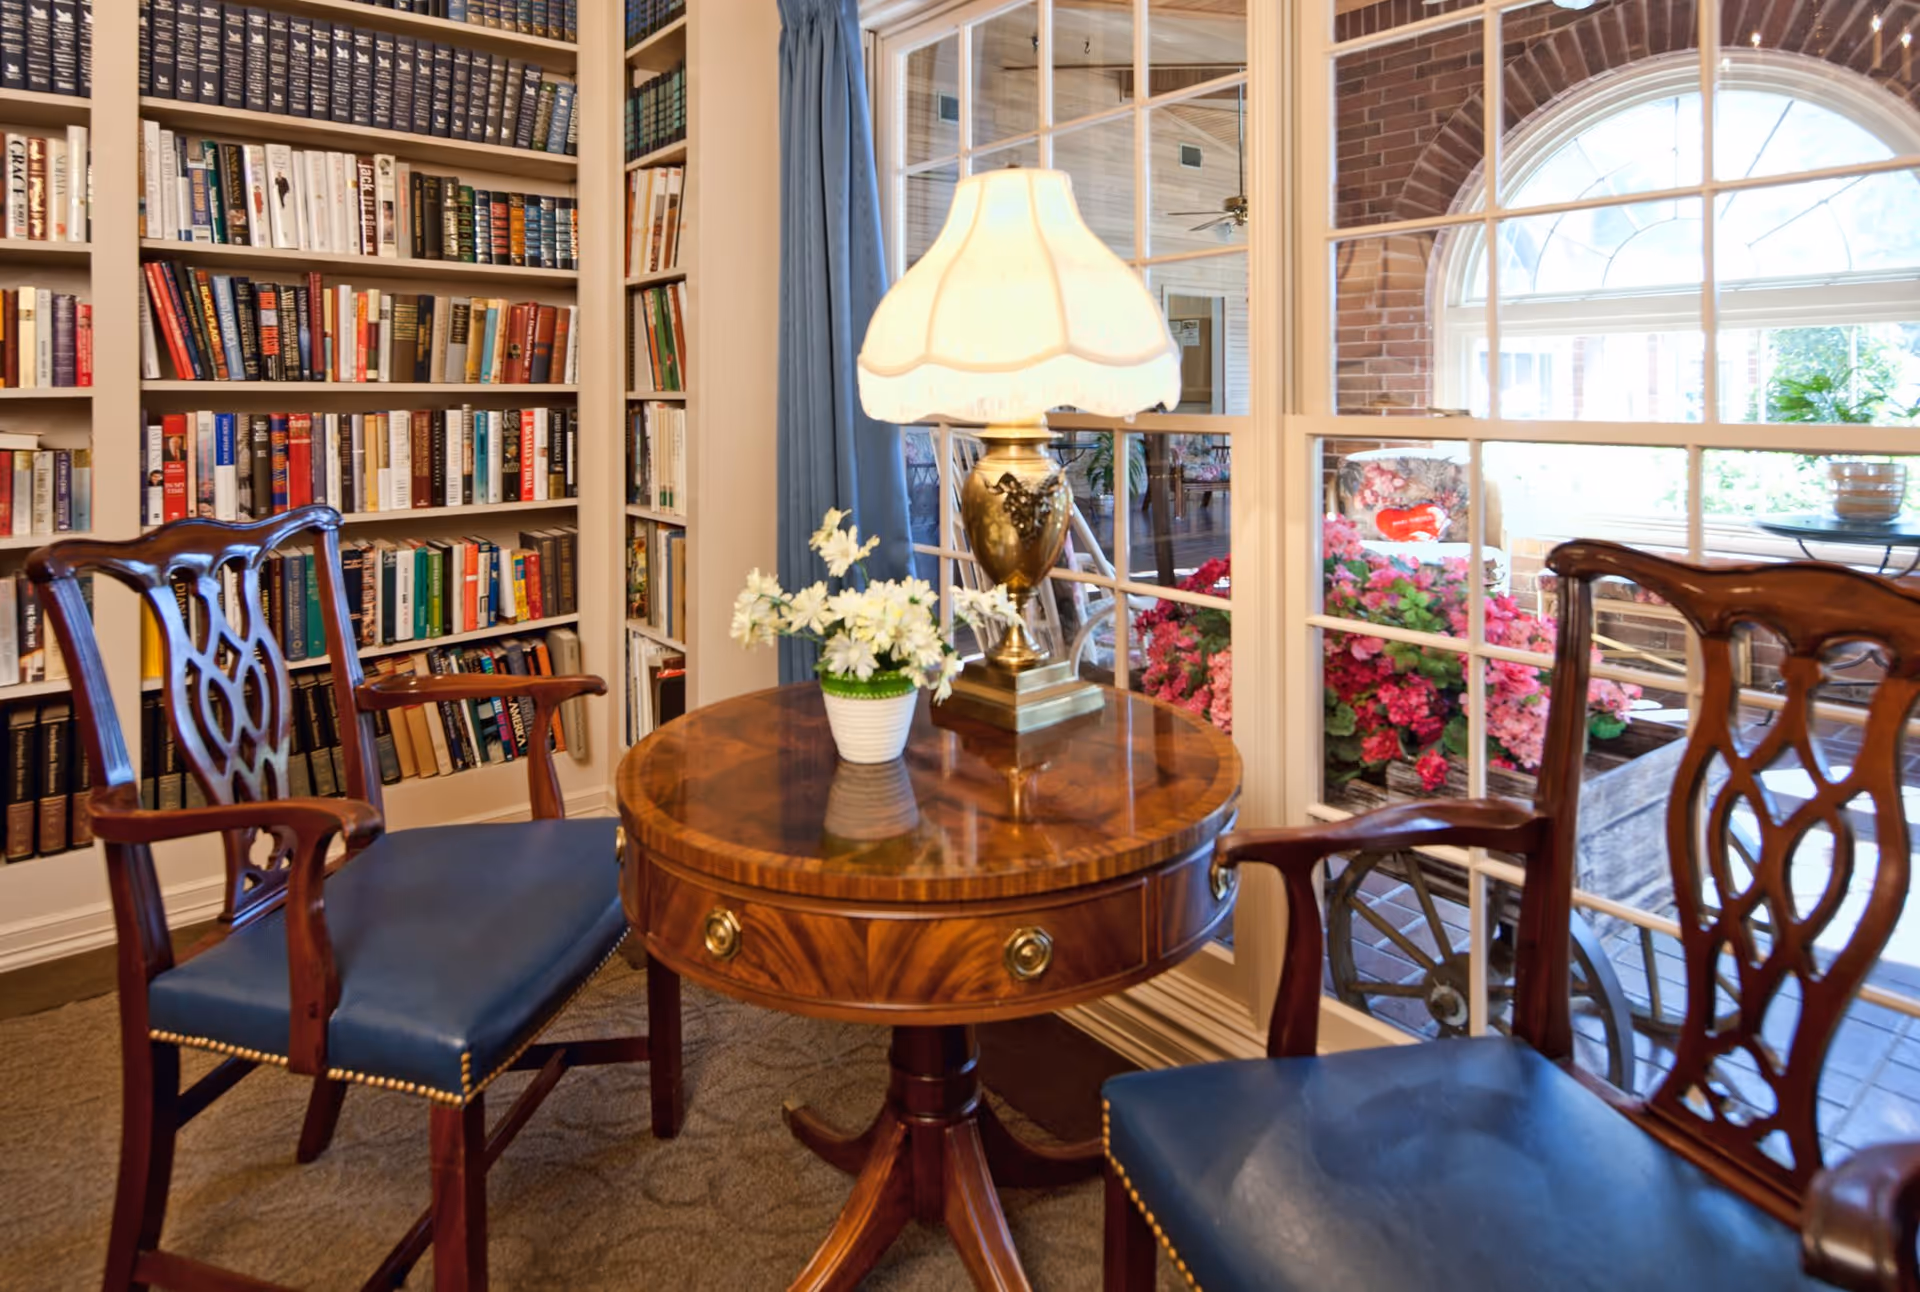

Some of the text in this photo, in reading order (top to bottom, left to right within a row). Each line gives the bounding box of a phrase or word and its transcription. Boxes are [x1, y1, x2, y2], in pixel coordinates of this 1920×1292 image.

[9, 140, 26, 198] GRACE
[358, 163, 374, 191] jack
[200, 285, 218, 342] BLACK FLAG
[524, 468, 532, 490] TRIAL
[508, 702, 526, 747] AMERICA
